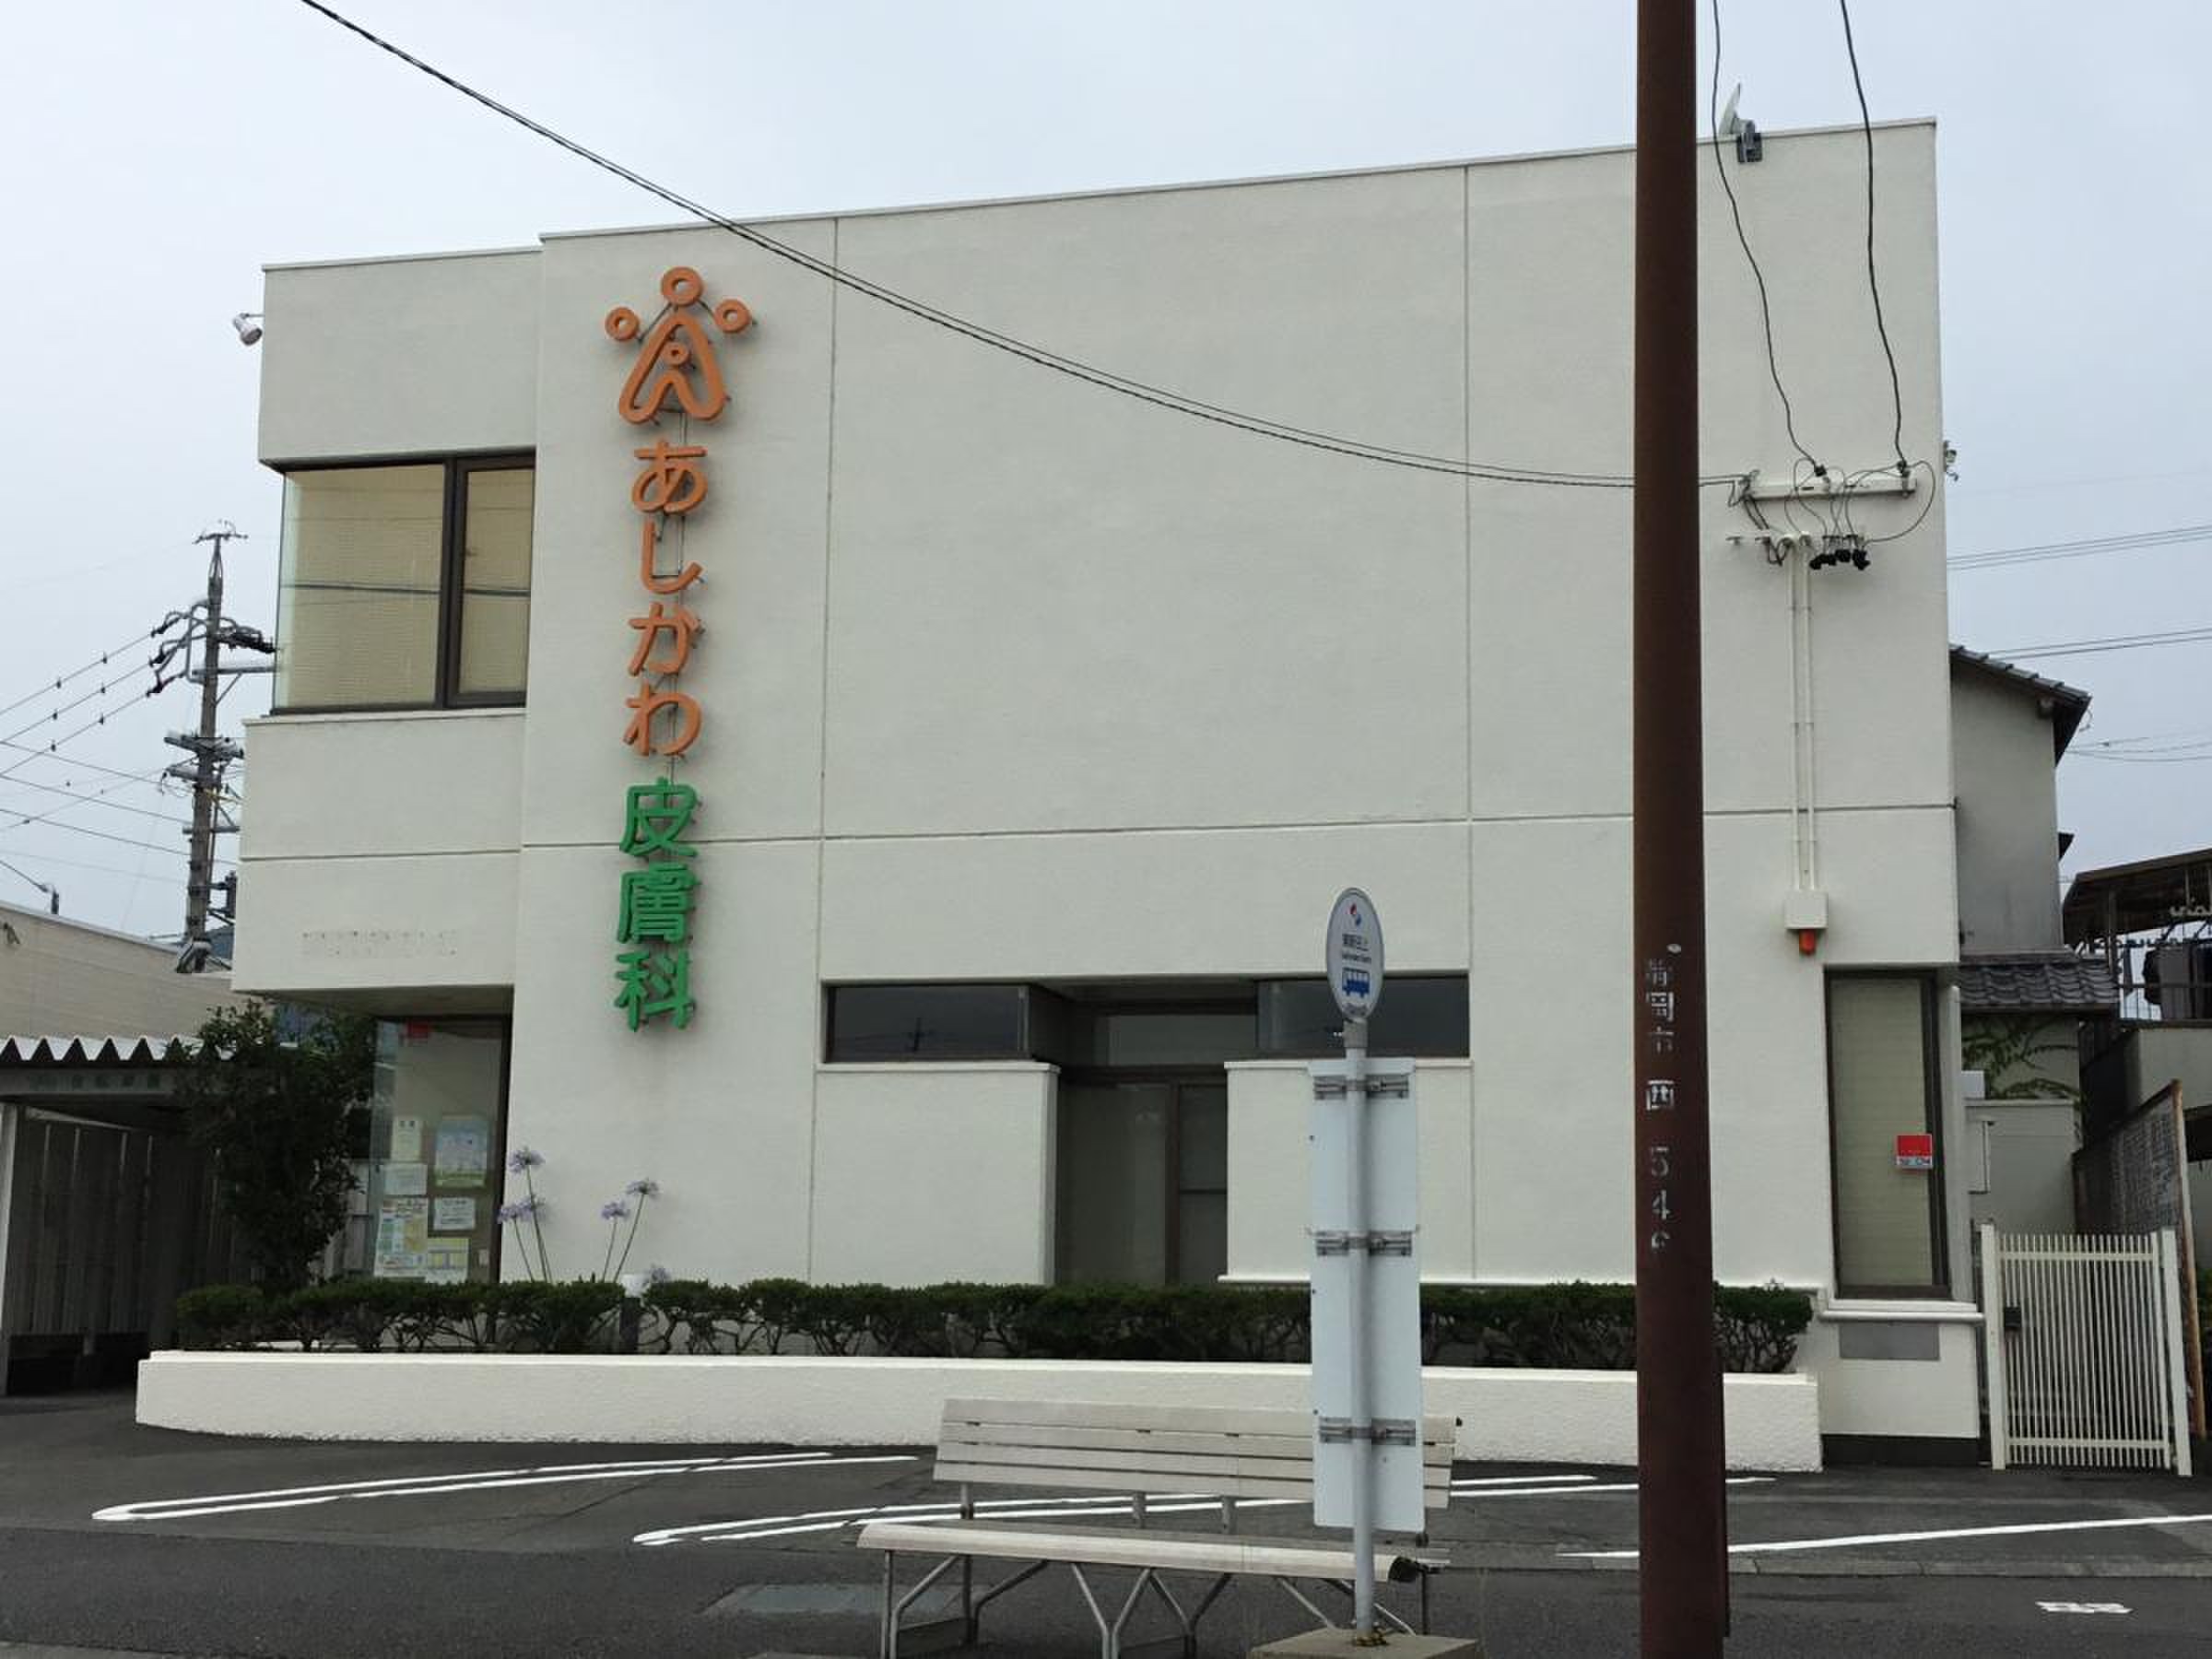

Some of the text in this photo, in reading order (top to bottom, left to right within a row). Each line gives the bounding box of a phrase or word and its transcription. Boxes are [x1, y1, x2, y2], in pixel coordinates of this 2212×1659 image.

[615, 438, 708, 1032] あしかわ皮膚科
